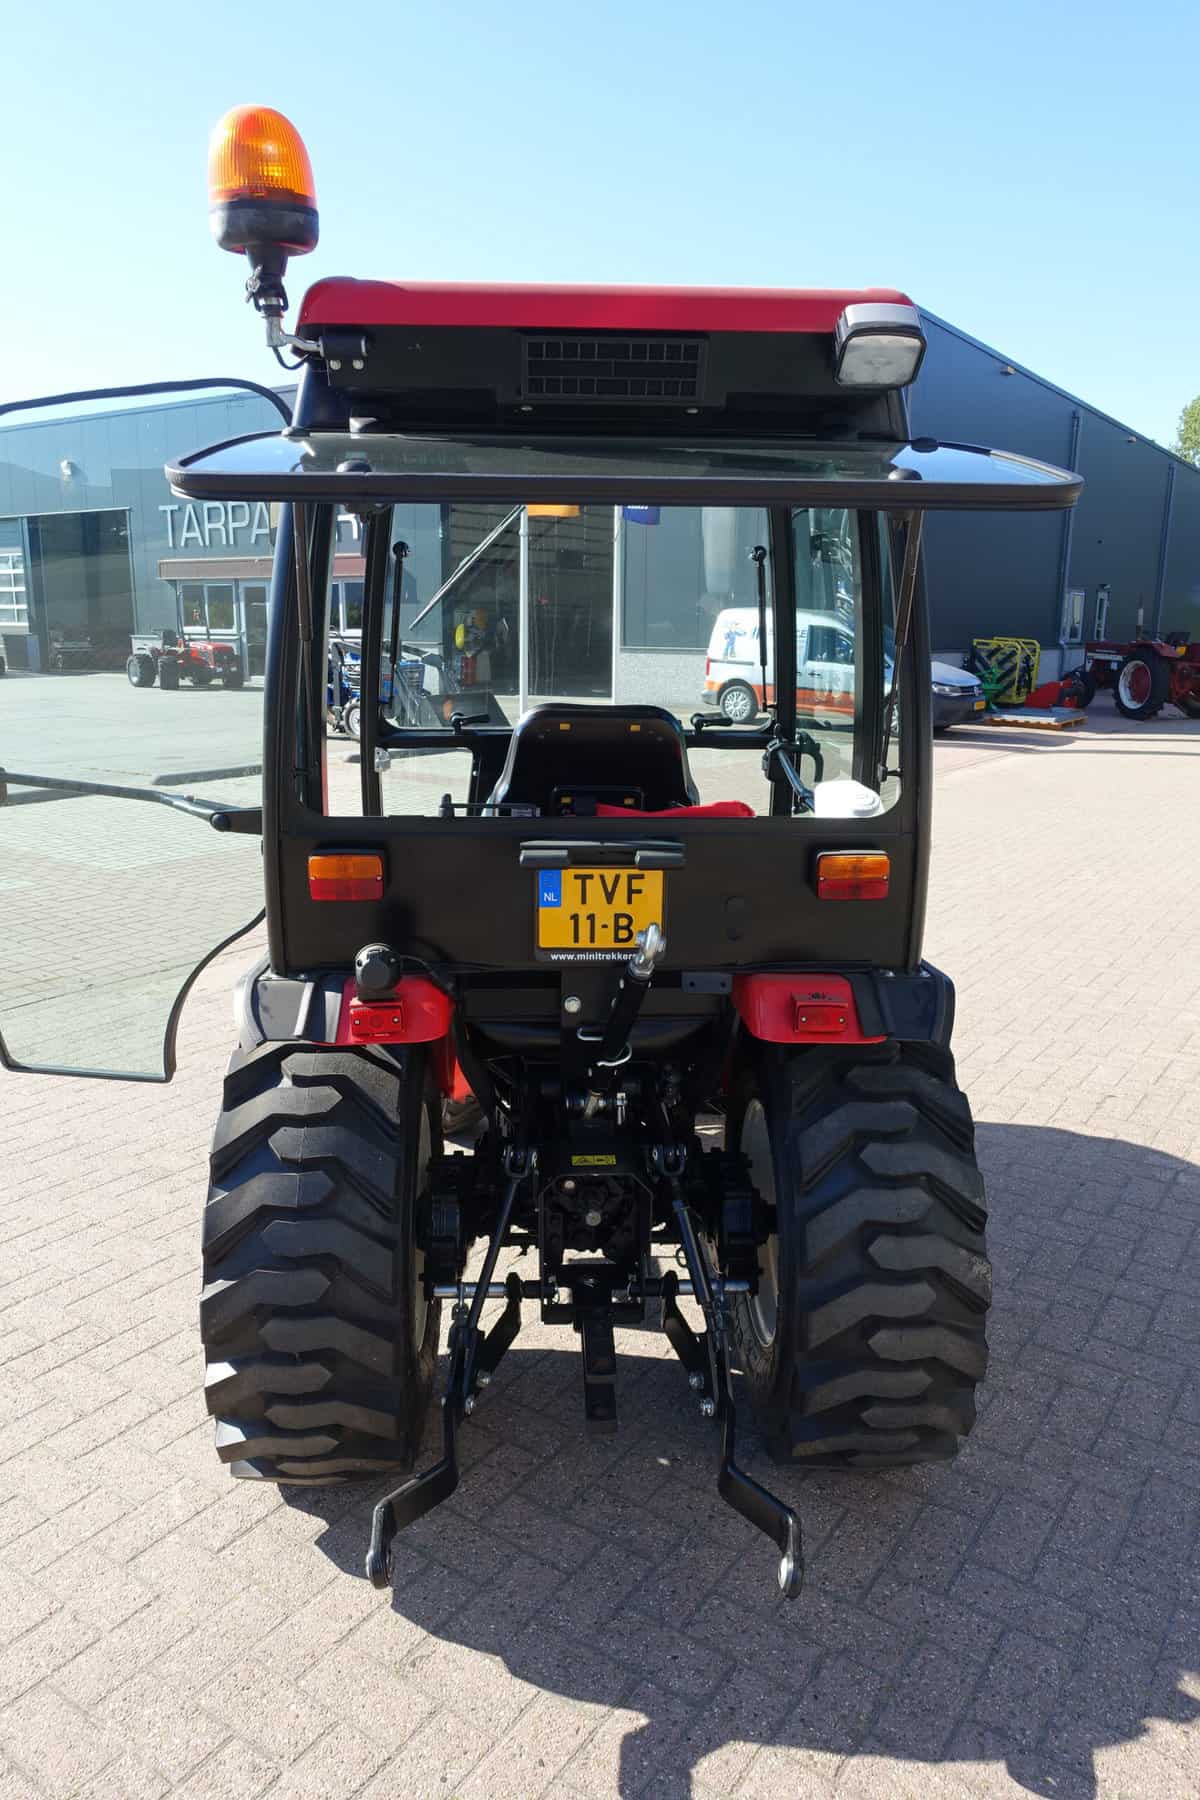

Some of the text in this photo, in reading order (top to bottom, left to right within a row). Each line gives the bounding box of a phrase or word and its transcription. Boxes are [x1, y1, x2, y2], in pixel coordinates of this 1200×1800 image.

[543, 893, 558, 902] NL
[573, 874, 645, 905] TVF
[569, 913, 634, 944] 11-B
